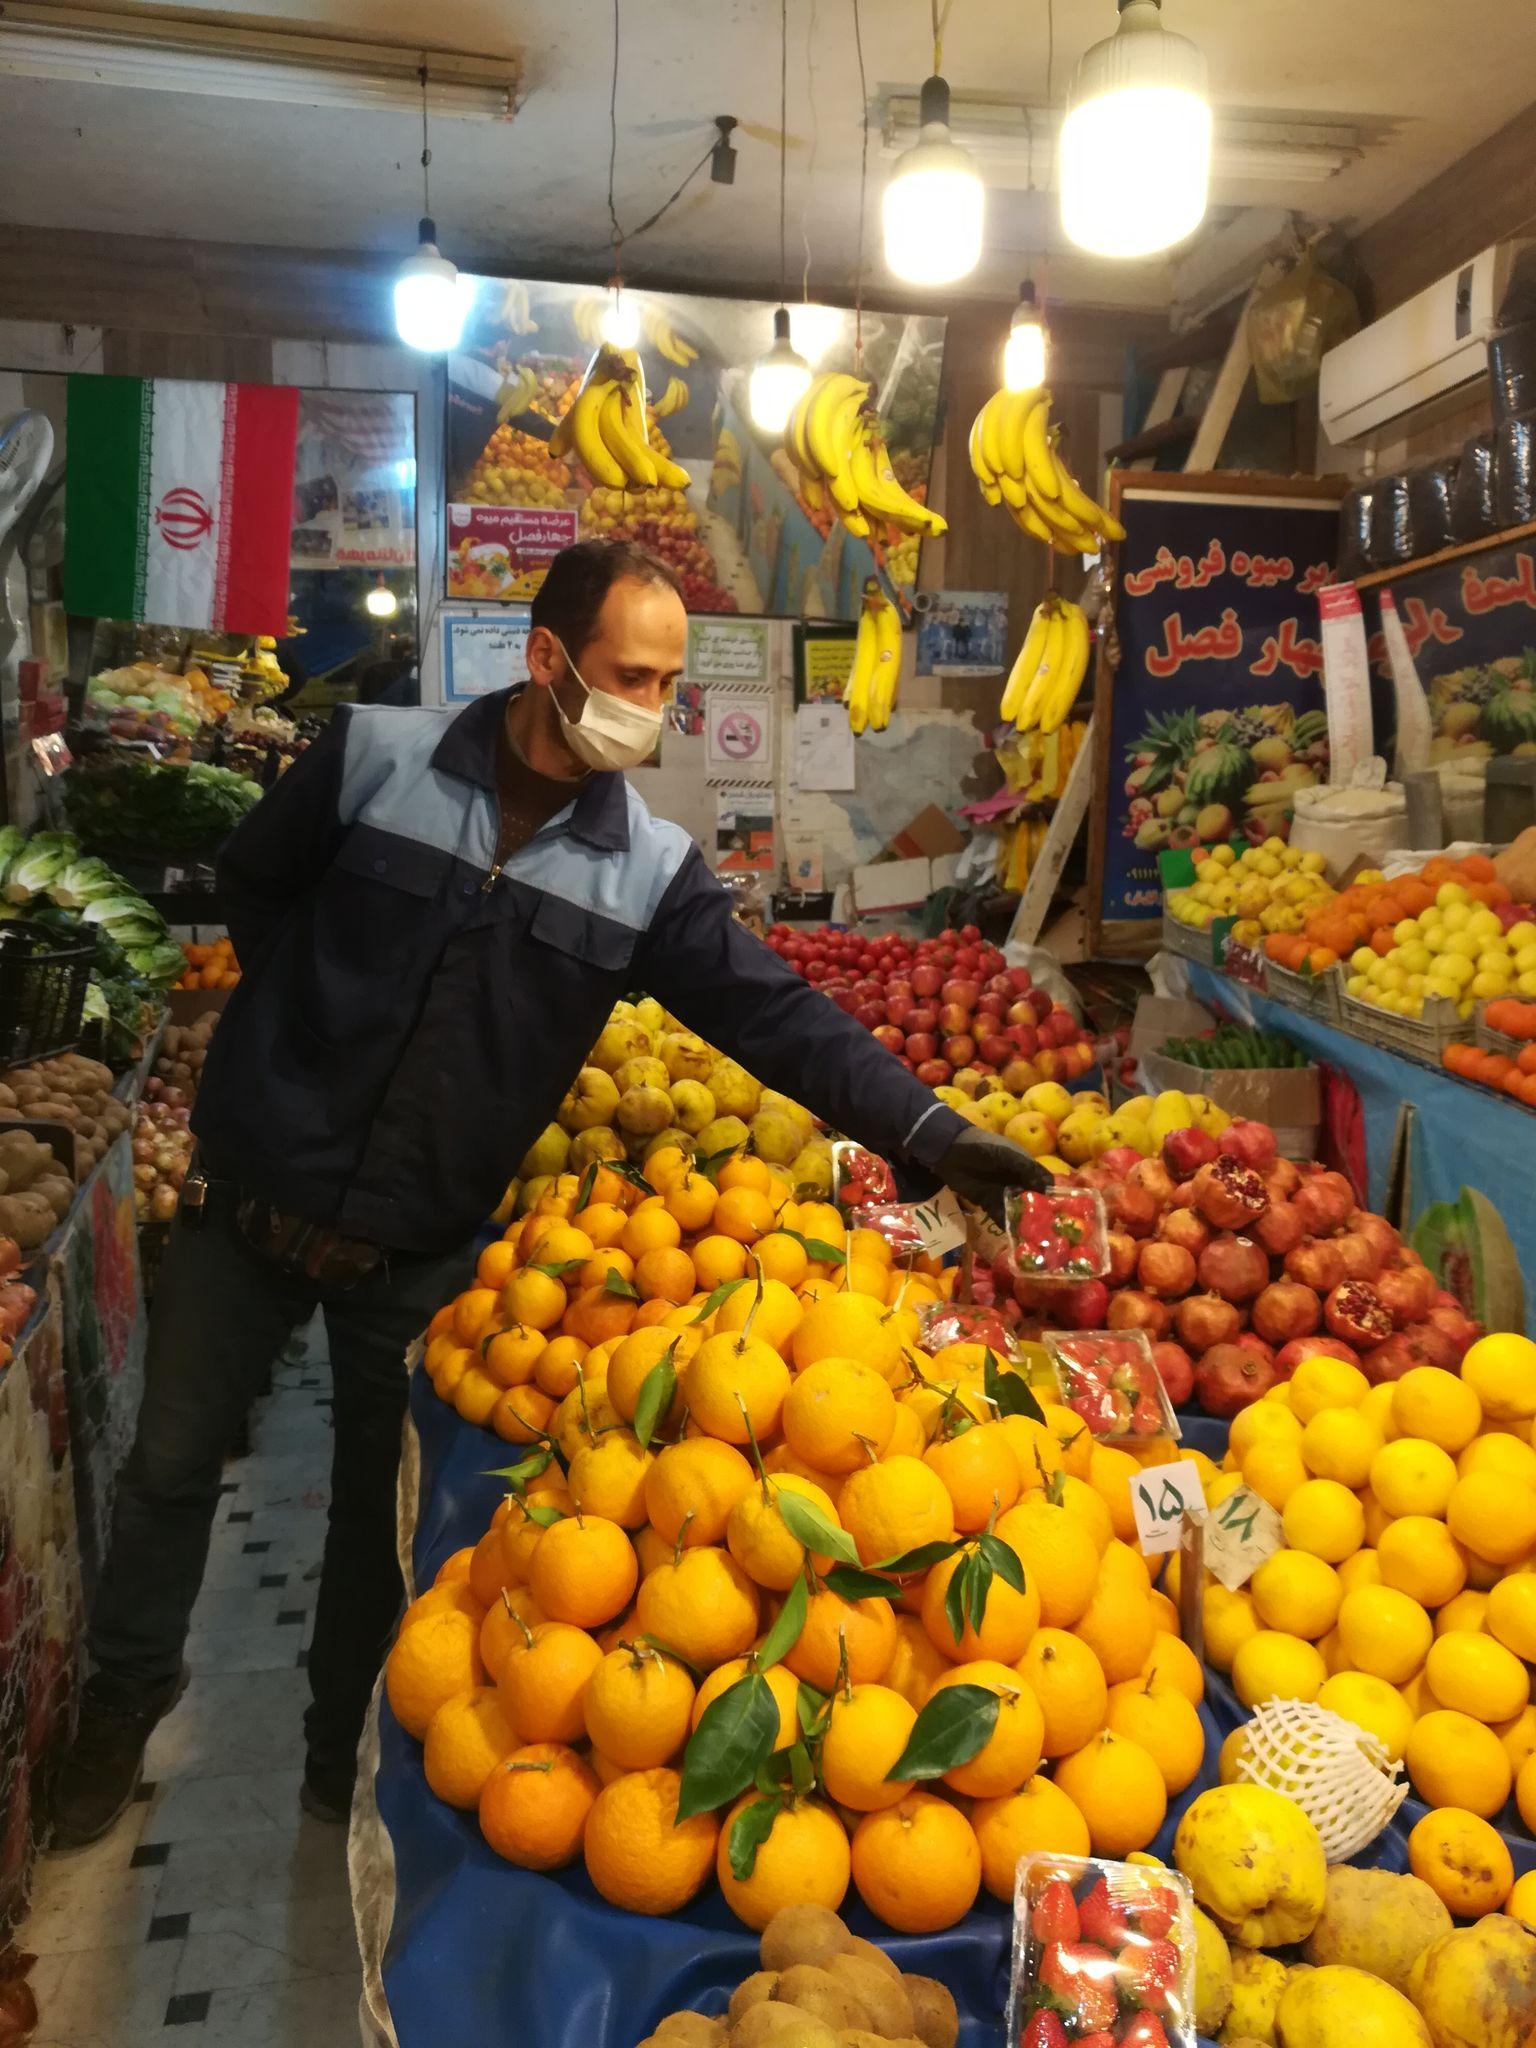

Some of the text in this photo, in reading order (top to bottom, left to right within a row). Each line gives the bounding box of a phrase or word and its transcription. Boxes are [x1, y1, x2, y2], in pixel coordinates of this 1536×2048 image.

[476, 513, 500, 524] میوه
[500, 513, 540, 526] مستقیم
[1123, 537, 1226, 598] فروشی
[1229, 550, 1294, 588] میوه
[1145, 606, 1324, 678] هار فصل
[1138, 1478, 1185, 1523] ۱۵
